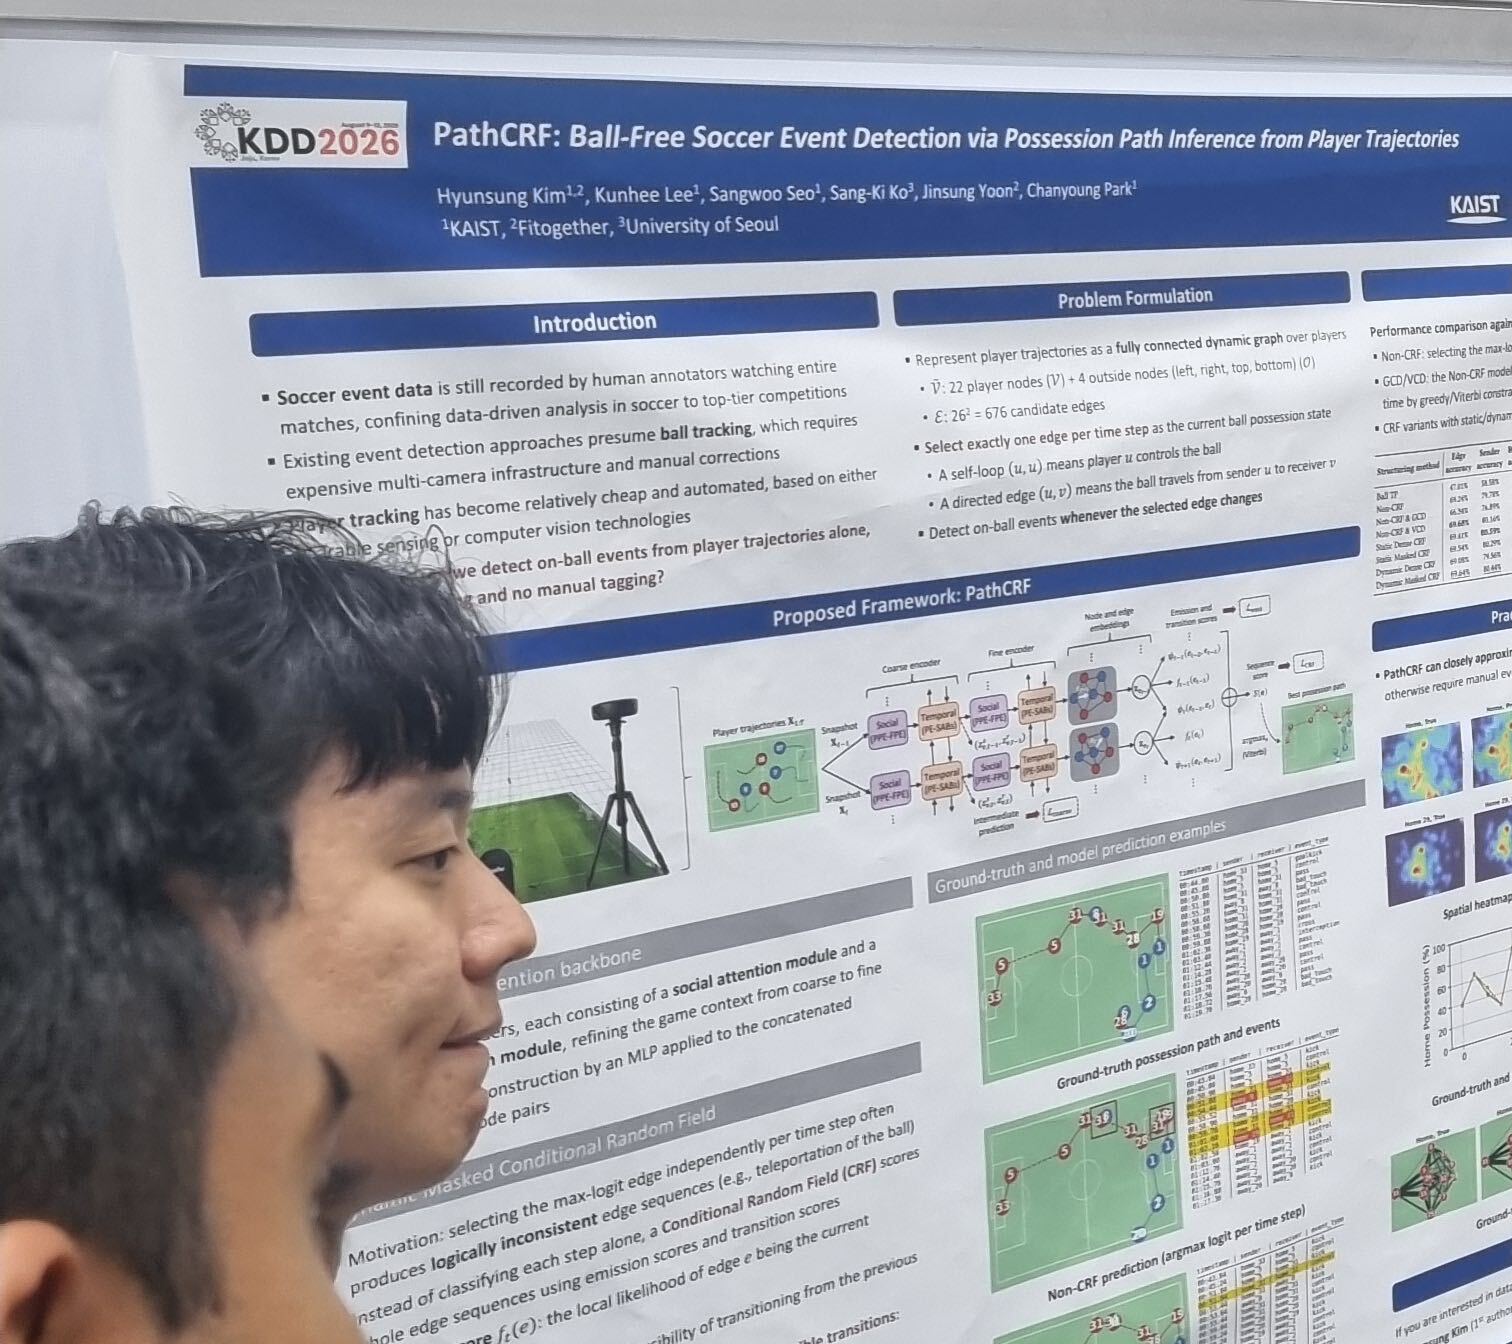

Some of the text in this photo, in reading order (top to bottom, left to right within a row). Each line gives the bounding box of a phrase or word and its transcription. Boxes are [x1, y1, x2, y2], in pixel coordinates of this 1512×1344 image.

[434, 120, 1459, 153] PathCRF: Ball-Free Soccer Event Detection via Possession Path Inference from Player Trajectories
[436, 187, 528, 208] Hyunsung
[595, 185, 660, 203] Kunhee
[709, 185, 782, 206] Sangwoo
[830, 184, 885, 204] Sang-Ki
[921, 183, 975, 202] Jinsung
[1026, 182, 1101, 200] Chanyoung
[1451, 195, 1501, 214] KAIST
[714, 215, 731, 232] of
[735, 215, 779, 232] Seoul
[1058, 287, 1213, 309] Problem Formulation
[534, 315, 657, 333] Introduction
[1369, 325, 1432, 337] Performance
[1434, 321, 1488, 334] comparison
[915, 330, 1347, 368] Represent player trajectories as a fully connected dynamic graph over players
[277, 361, 837, 405] Soccer event data is still recorded by human annotators watching entire
[481, 524, 870, 576] detect on-ball events from player trajectories alone,
[773, 578, 1031, 627] Proposed Framework: PathCRF
[1383, 663, 1423, 680] PathCRF
[1425, 662, 1441, 672] can
[1443, 654, 1473, 669] closely
[935, 820, 1226, 893] Ground-truth and model prediction examples
[1443, 901, 1472, 921] Spatial
[560, 948, 641, 977] backbone
[1433, 945, 1446, 955] 100
[1056, 1018, 1280, 1089] Ground-truth possession path and events
[1431, 1078, 1492, 1106] Ground-truth
[1493, 1071, 1510, 1086] and
[499, 1136, 601, 1176] Conditional
[606, 1120, 674, 1150] Random
[677, 1105, 716, 1129] Field
[1047, 1203, 1305, 1302] Non-CRF prediction (argmax logit per time step)
[826, 1311, 899, 1343] transitions:
[1451, 1326, 1469, 1339] Kim
